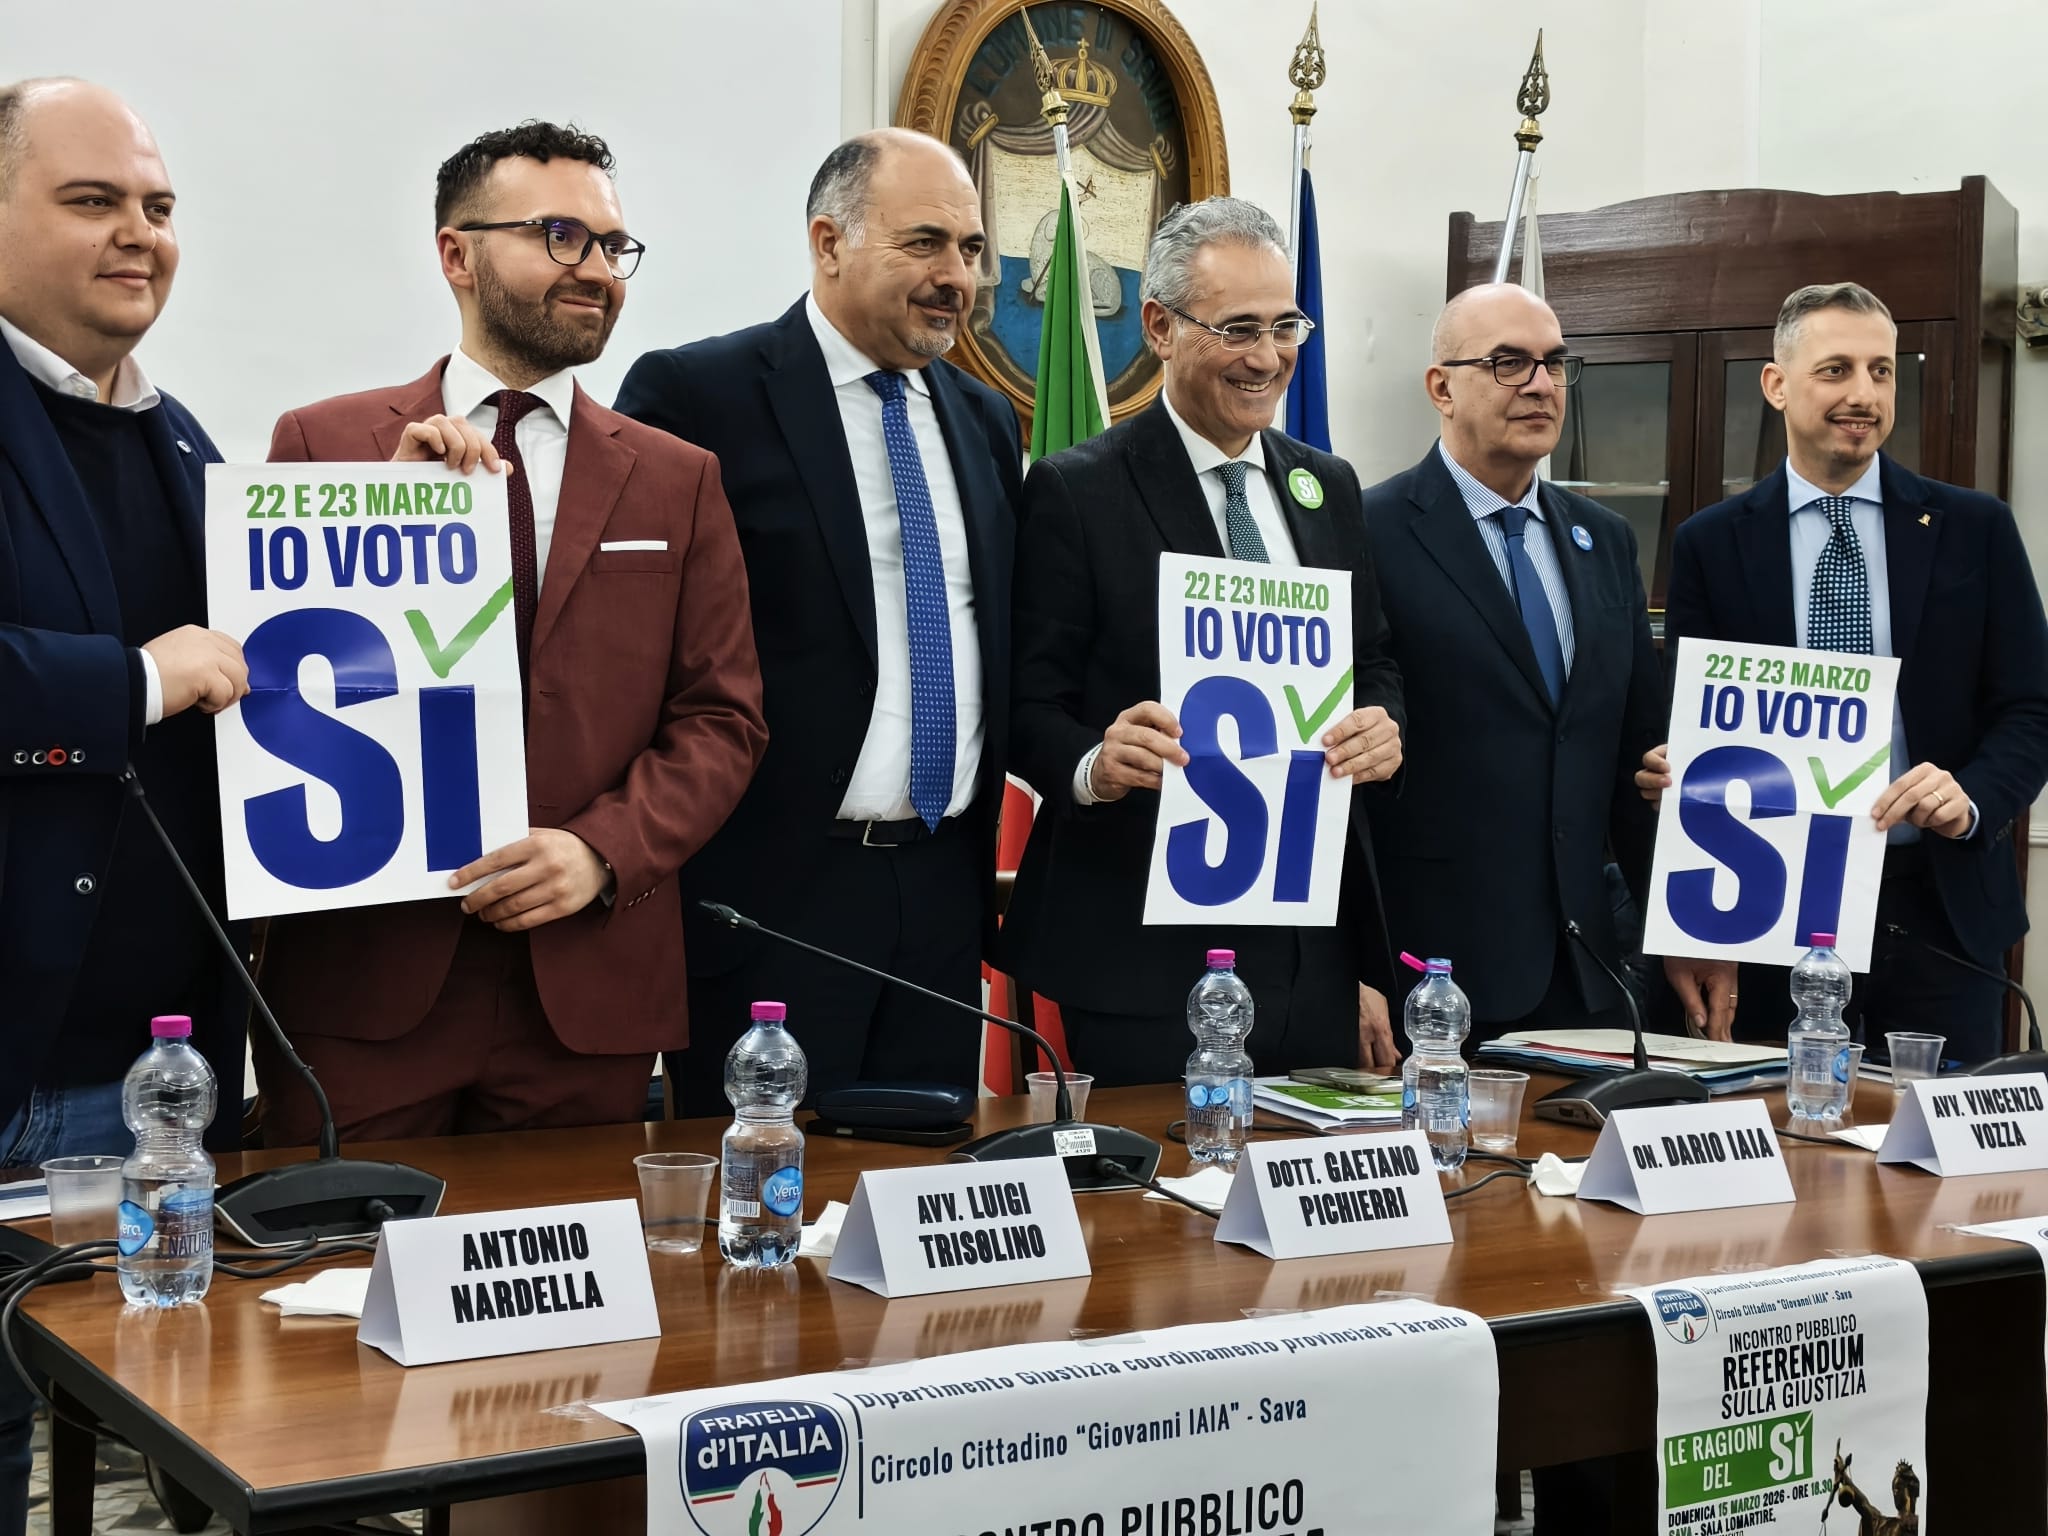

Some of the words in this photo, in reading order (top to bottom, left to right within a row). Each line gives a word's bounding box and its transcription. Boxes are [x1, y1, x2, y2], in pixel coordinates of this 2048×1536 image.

[246, 484, 286, 518] 22
[295, 483, 311, 517] E
[319, 482, 357, 517] 23
[366, 481, 473, 516] MARZO
[248, 526, 309, 591] IO
[322, 522, 478, 588] VOTO
[1185, 570, 1210, 600] 22
[1215, 574, 1226, 602] E
[1230, 575, 1255, 605] 23
[1260, 578, 1330, 611] MARZO
[1185, 606, 1223, 660] IO
[1232, 611, 1331, 668] VOTO
[1705, 653, 1735, 680] 22
[1739, 657, 1752, 682] E
[1756, 658, 1786, 685] 23
[1790, 661, 1871, 692] MARZO
[1700, 684, 1745, 731] IO
[1757, 689, 1867, 743] VOTO
[1932, 1094, 1965, 1118] AVV.
[1963, 1086, 2044, 1115] VINCENZO
[1632, 1145, 1662, 1170] ON.
[1661, 1132, 1726, 1167] DARIO
[1725, 1128, 1774, 1161] IAIA
[1970, 1121, 2027, 1149] VOZZA
[1266, 1158, 1322, 1188] DOTT.
[1324, 1145, 1420, 1183] GAETANO
[917, 1192, 964, 1224] AVV.
[967, 1182, 1032, 1220] LUIGI
[1299, 1187, 1408, 1227] PICHIERRI
[462, 1222, 590, 1271] ANTONIO
[919, 1224, 1046, 1268] TRISOLINO
[450, 1270, 604, 1323] NARDELLA
[1715, 1306, 1742, 1320] Circolo
[1742, 1302, 1777, 1317] Cittadino
[1834, 1289, 1853, 1301] Sava
[1729, 1324, 1792, 1353] INCONTRO
[1796, 1314, 1857, 1341] PUBBLICO
[854, 1375, 1015, 1409] Dipartimento
[1015, 1361, 1121, 1386] Giustizia
[1123, 1340, 1279, 1372] coordinamento
[1281, 1326, 1392, 1355] provinciale
[1390, 1314, 1468, 1337] Taranto
[1723, 1333, 1865, 1391] REFERENDUM
[1721, 1384, 1776, 1420] SULLA
[1782, 1369, 1867, 1409] GIUSTIZIA
[699, 1405, 817, 1435] FRATELLI
[871, 1448, 953, 1485] Circolo
[962, 1431, 1068, 1470] Cittadino
[1260, 1397, 1306, 1424] Sava
[697, 1424, 833, 1470] d'ITALIA
[1668, 1438, 1687, 1467] LE
[1692, 1423, 1763, 1462] RAGIONI
[1703, 1462, 1732, 1491] DEL
[1122, 1478, 1304, 1536] PUBBLICO
[1668, 1505, 1716, 1528] DOMENICA
[1718, 1501, 1728, 1517] 15
[1730, 1494, 1760, 1515] MARZO
[1762, 1489, 1785, 1507] 2026
[1792, 1484, 1809, 1500] ORE
[1811, 1477, 1833, 1497] 18.30
[1700, 1517, 1723, 1536] SALA
[1725, 1507, 1776, 1535] LOMARTIRE,
